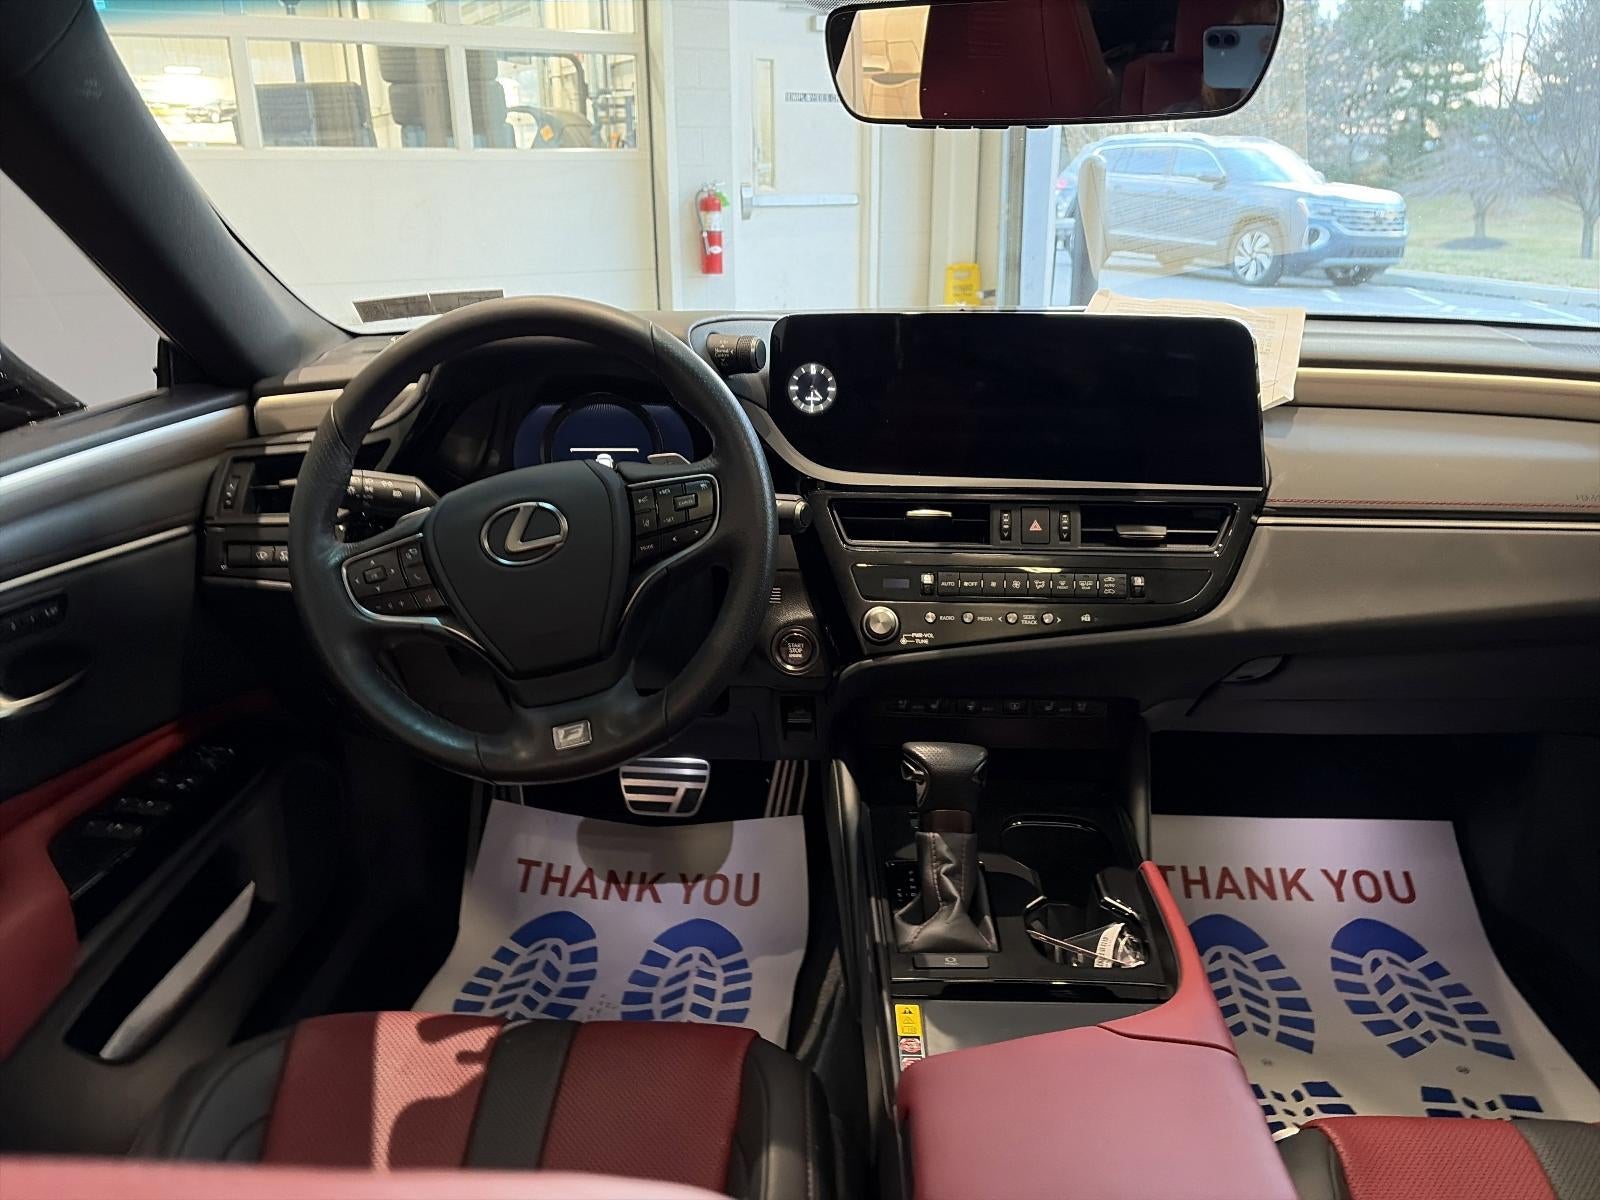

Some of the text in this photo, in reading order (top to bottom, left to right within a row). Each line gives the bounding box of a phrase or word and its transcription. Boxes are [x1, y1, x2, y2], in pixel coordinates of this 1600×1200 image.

[517, 857, 761, 907] THANK YOU
[1320, 868, 1417, 904] YOU
